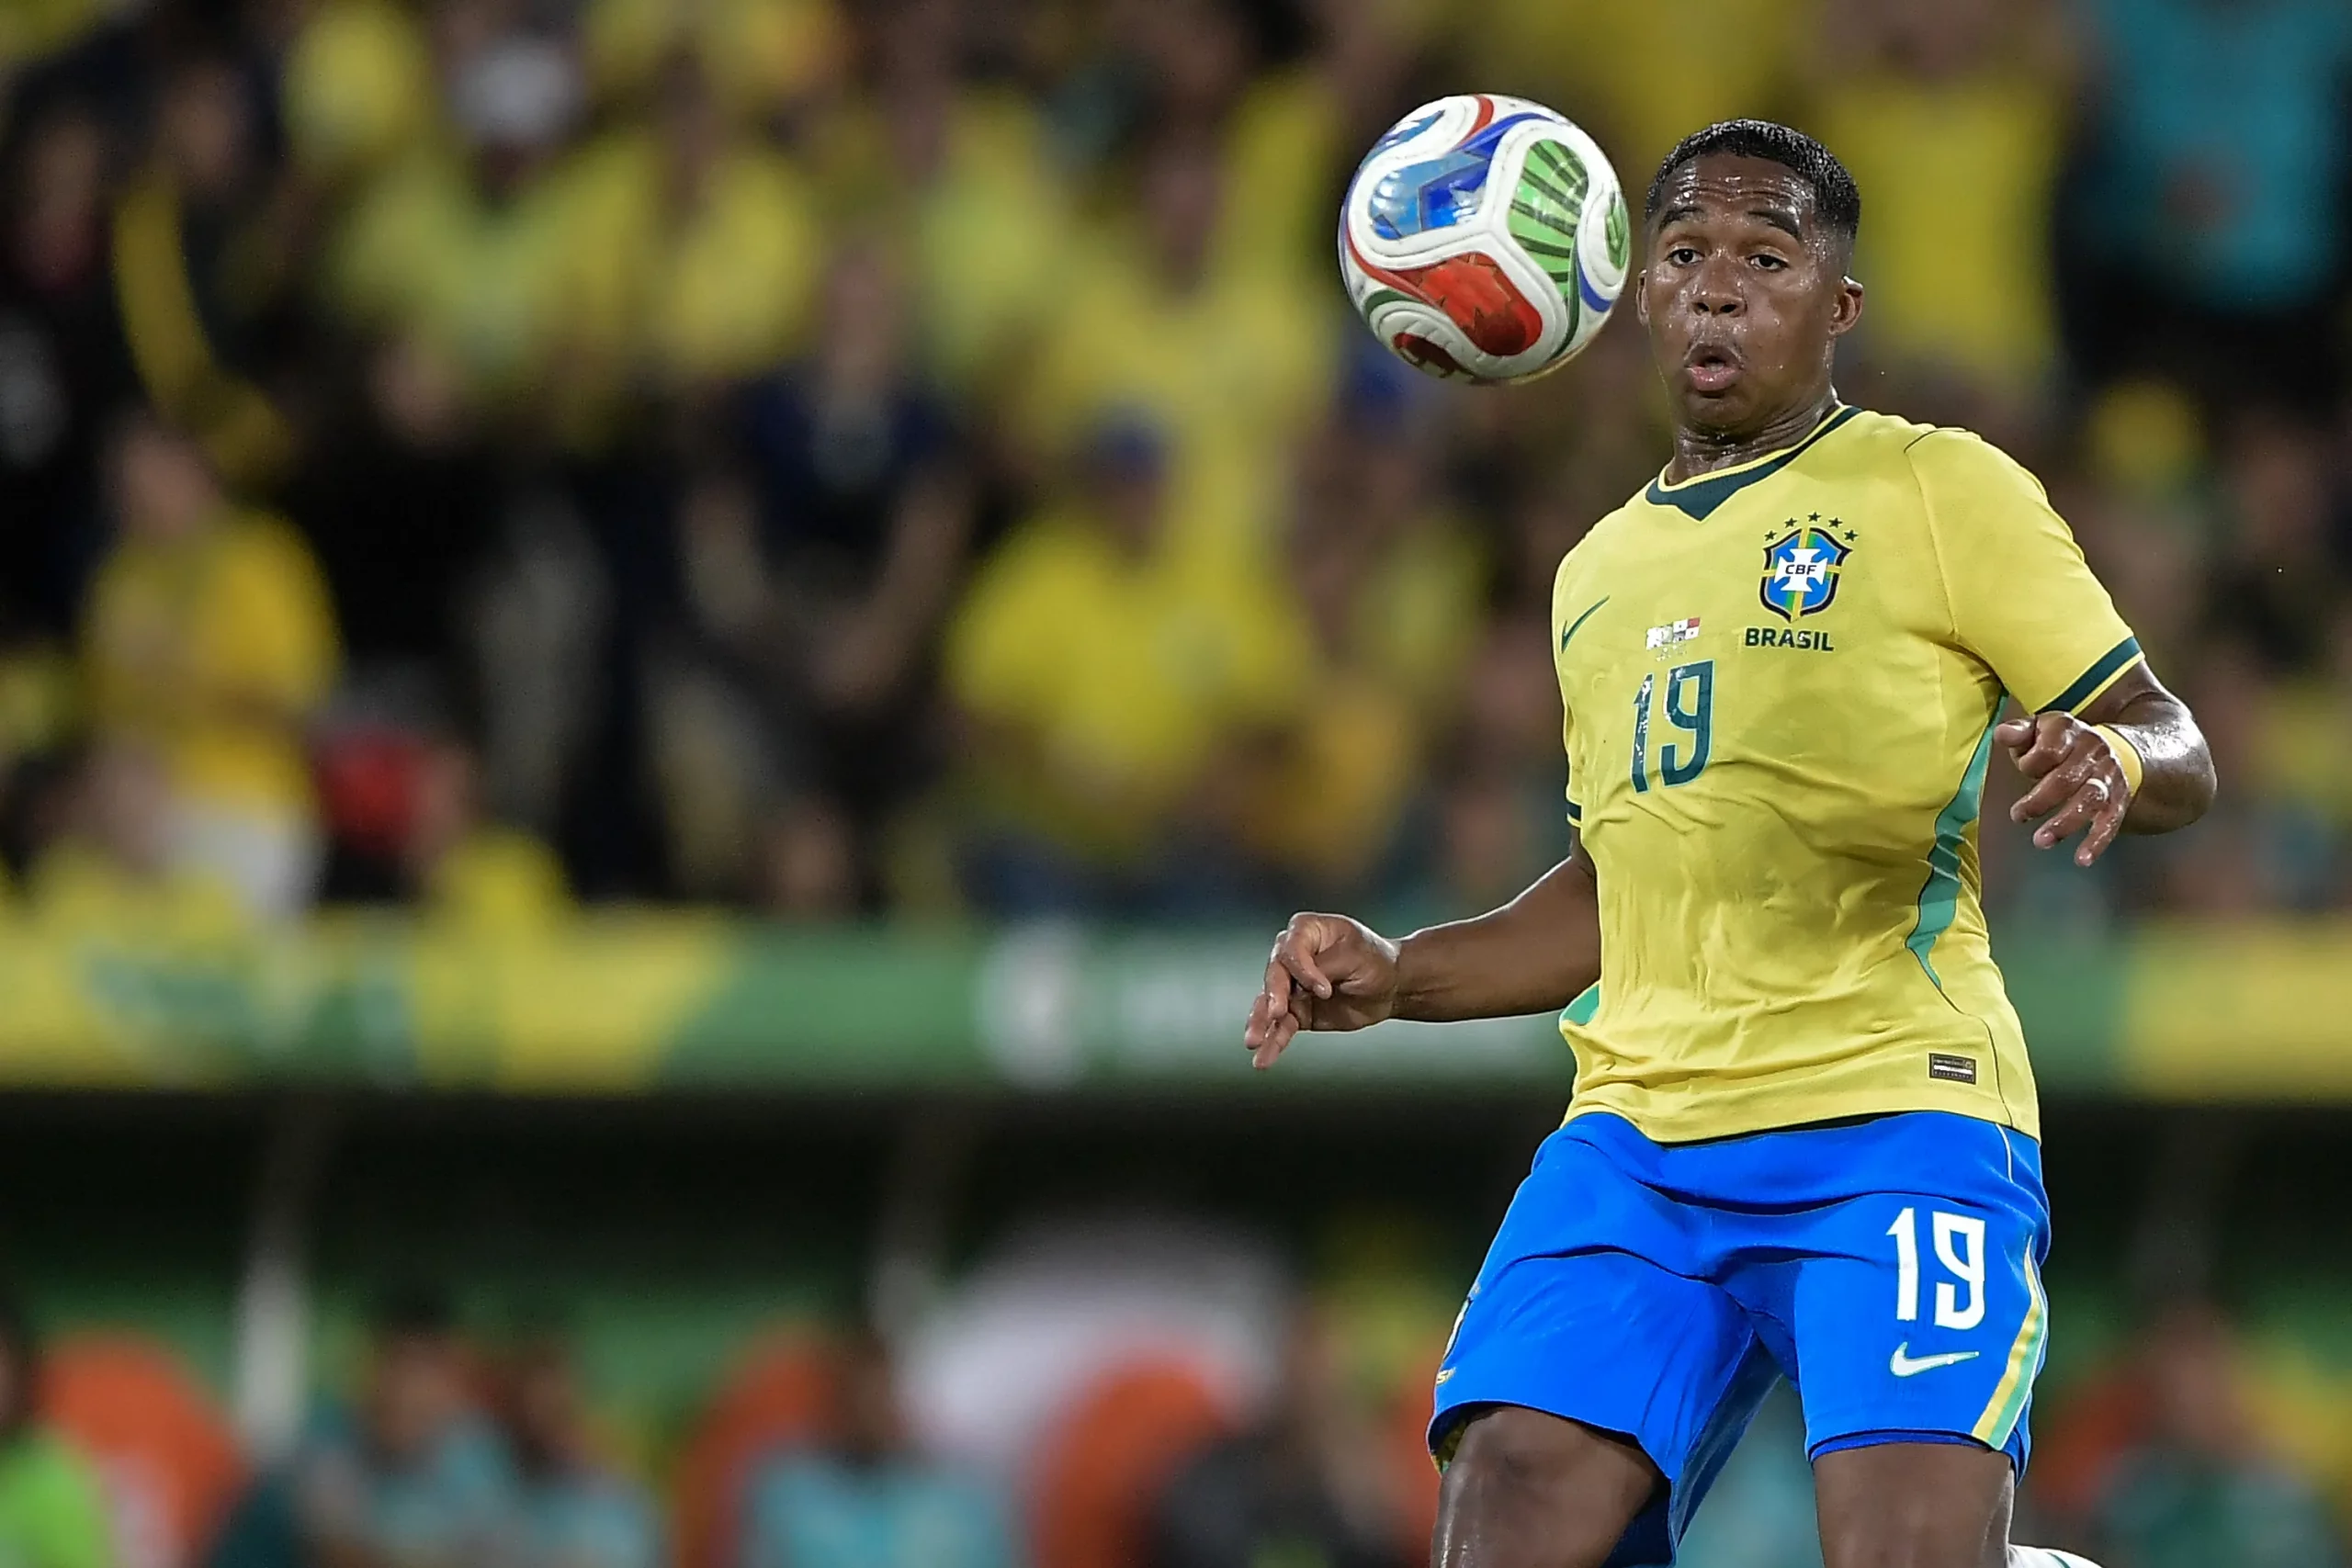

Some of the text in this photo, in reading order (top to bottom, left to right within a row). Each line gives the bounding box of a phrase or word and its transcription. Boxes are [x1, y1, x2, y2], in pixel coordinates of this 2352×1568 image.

[1785, 564, 1817, 576] CBF
[1746, 627, 1835, 651] BRASIL
[1631, 659, 1715, 794] 19
[1885, 1207, 1985, 1330] 19
